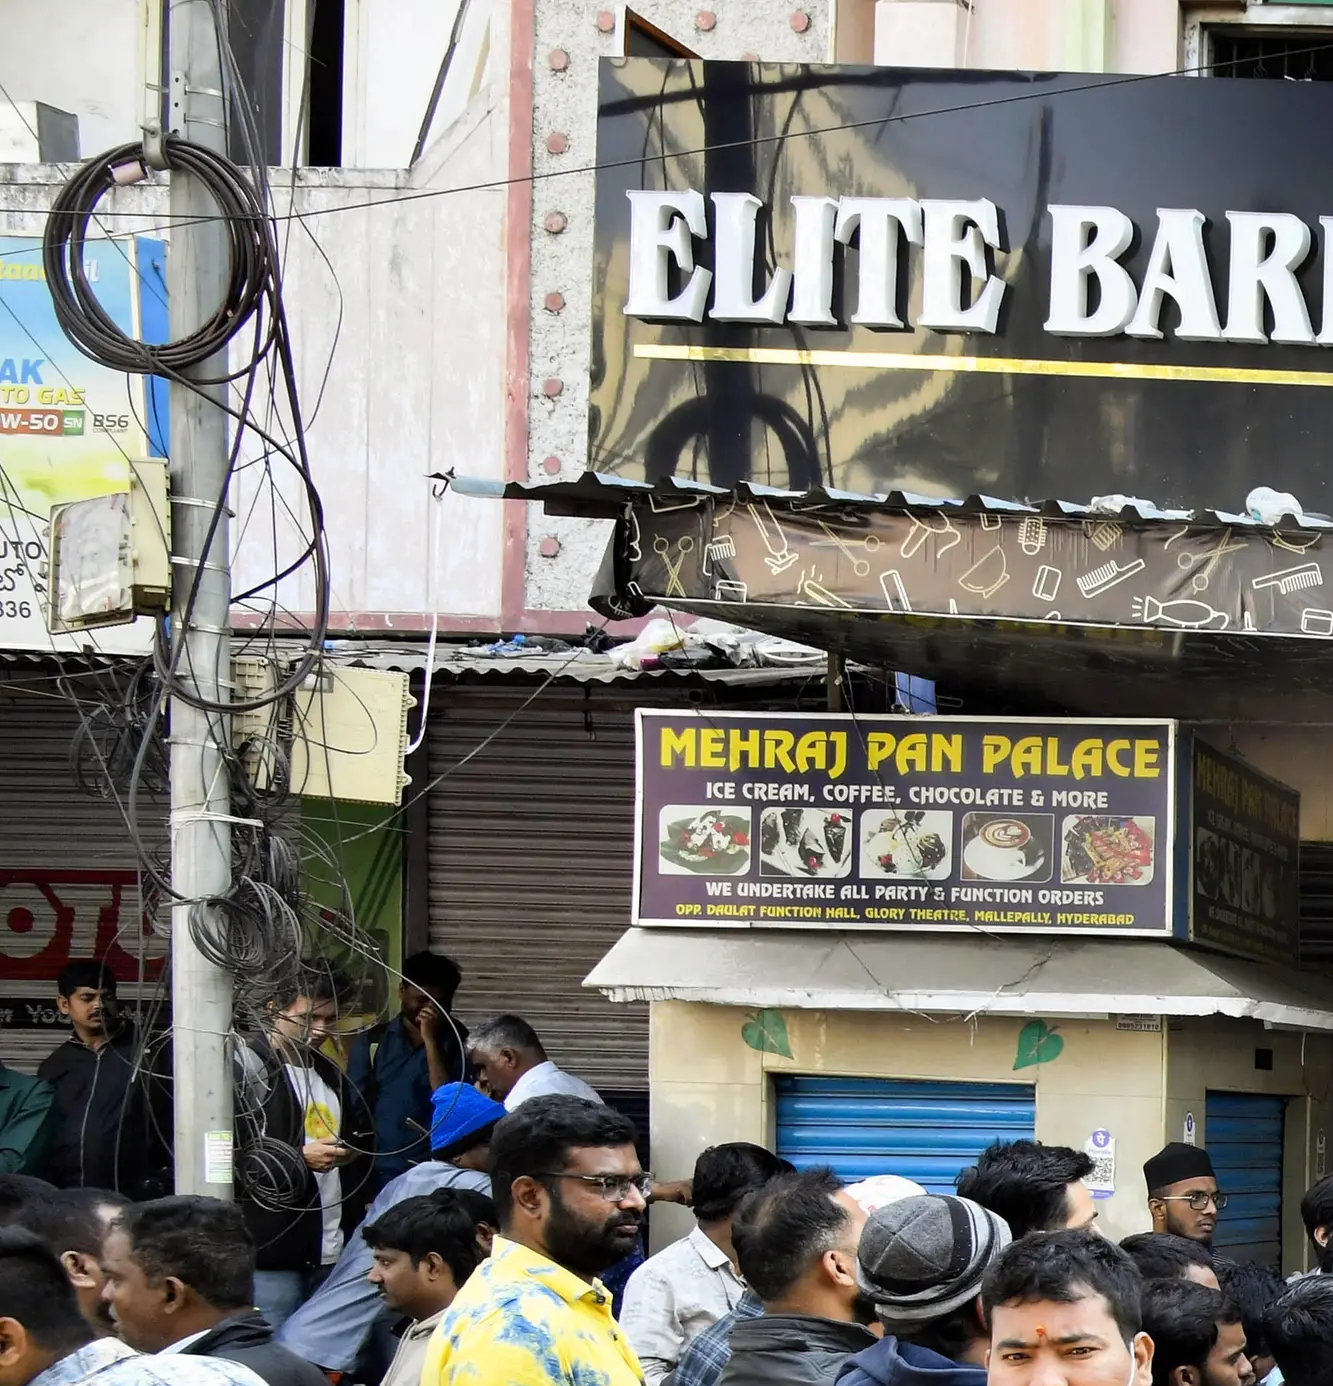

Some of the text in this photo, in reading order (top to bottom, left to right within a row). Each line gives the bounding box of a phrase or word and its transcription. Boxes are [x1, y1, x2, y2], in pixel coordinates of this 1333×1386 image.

[624, 189, 1006, 334] ELITE
[38, 388, 85, 406] GAS
[93, 414, 129, 427] BS6
[660, 727, 1160, 781] MEHRAJ PAN PALACE
[706, 781, 1108, 809] ICE CREAM, COFFEE, CHOCOLATE & MORE
[706, 882, 1104, 906] WE UNDERTAKE ALL PARTY & FUNCTION ORDERS
[676, 903, 1134, 925] OPP. DAULAT FUNCTION HALL, GLORY THEATRE, MALLEPALLY, HYDERABAD
